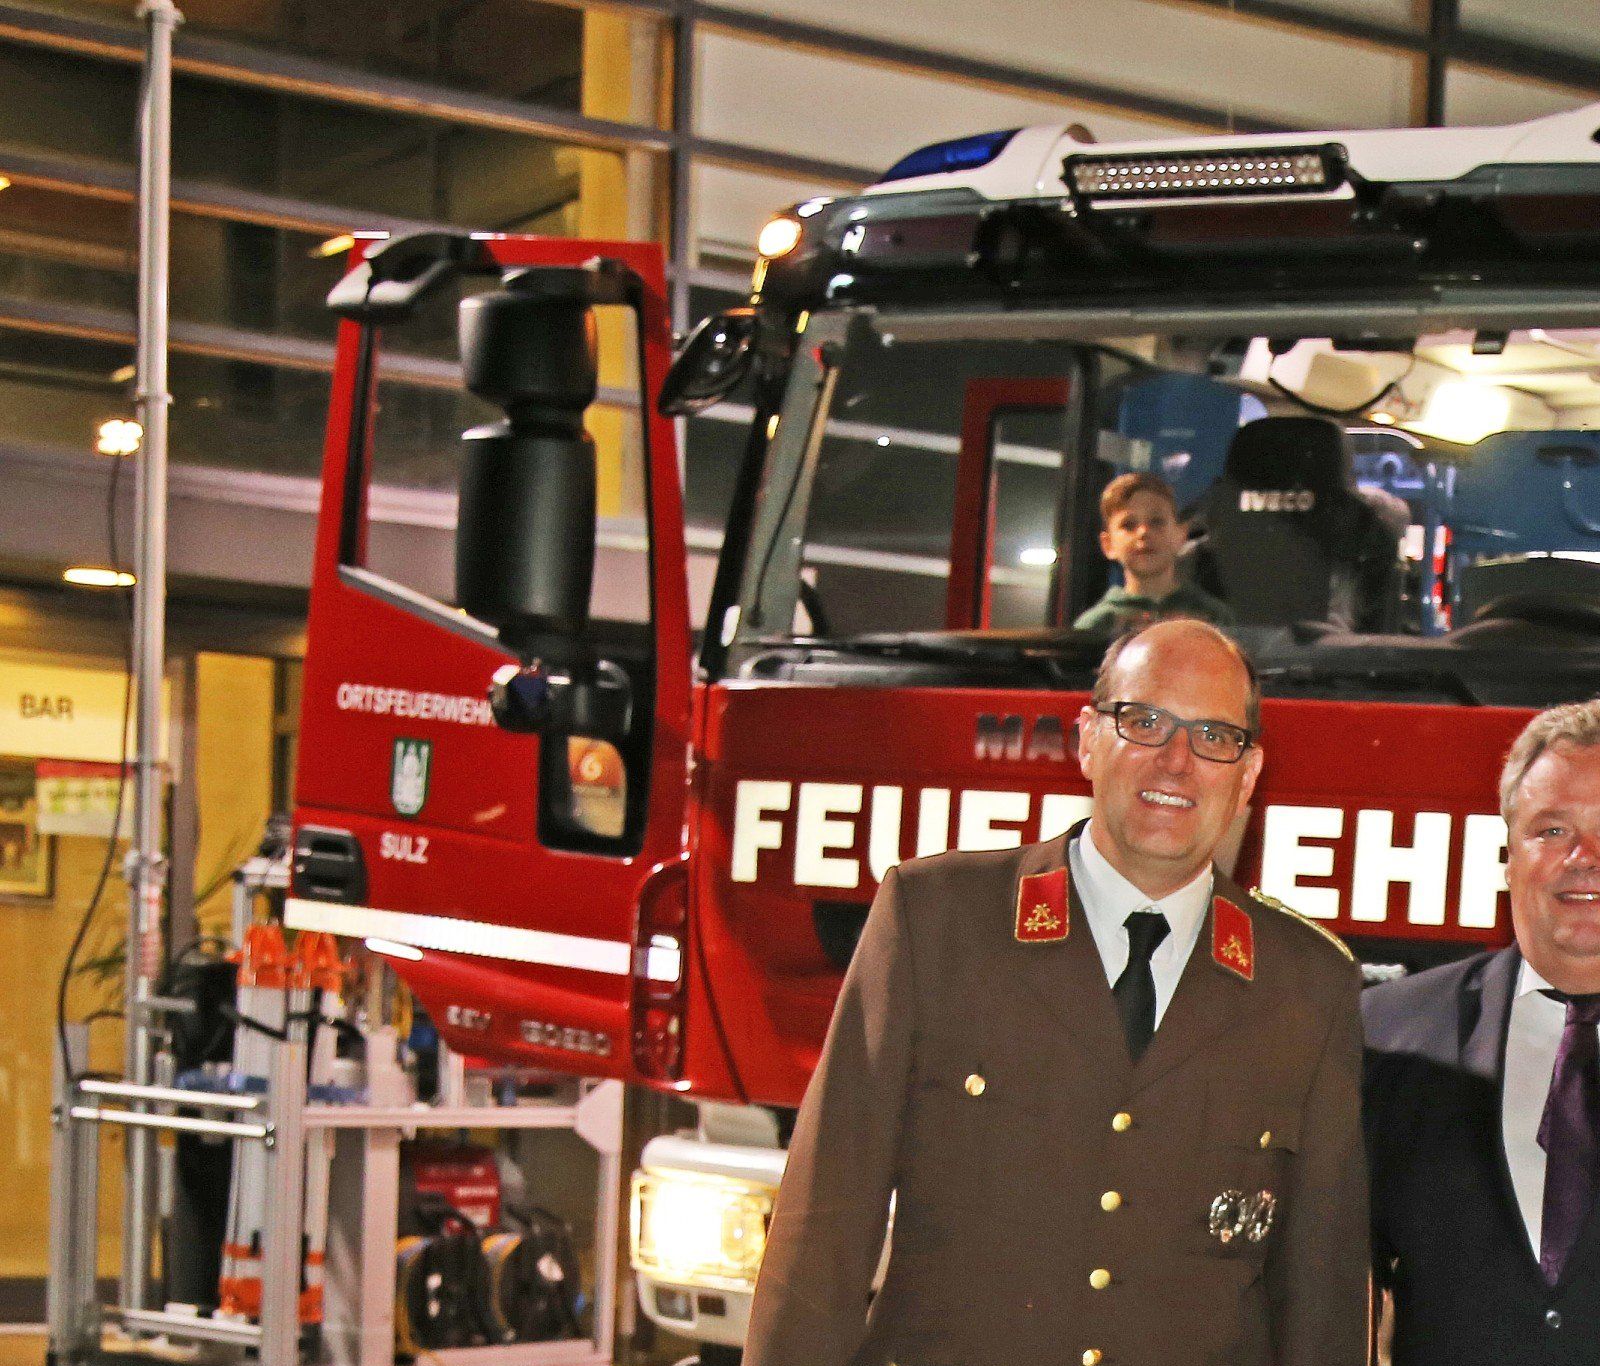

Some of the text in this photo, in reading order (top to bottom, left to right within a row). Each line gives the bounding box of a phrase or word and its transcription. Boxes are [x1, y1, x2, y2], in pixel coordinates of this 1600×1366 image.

[19, 693, 74, 719] BAR
[337, 682, 499, 726] ORTSFEUERWEH
[976, 712, 1080, 760] MA
[380, 832, 430, 864] SULZ
[731, 780, 1510, 929] FEUEEHR
